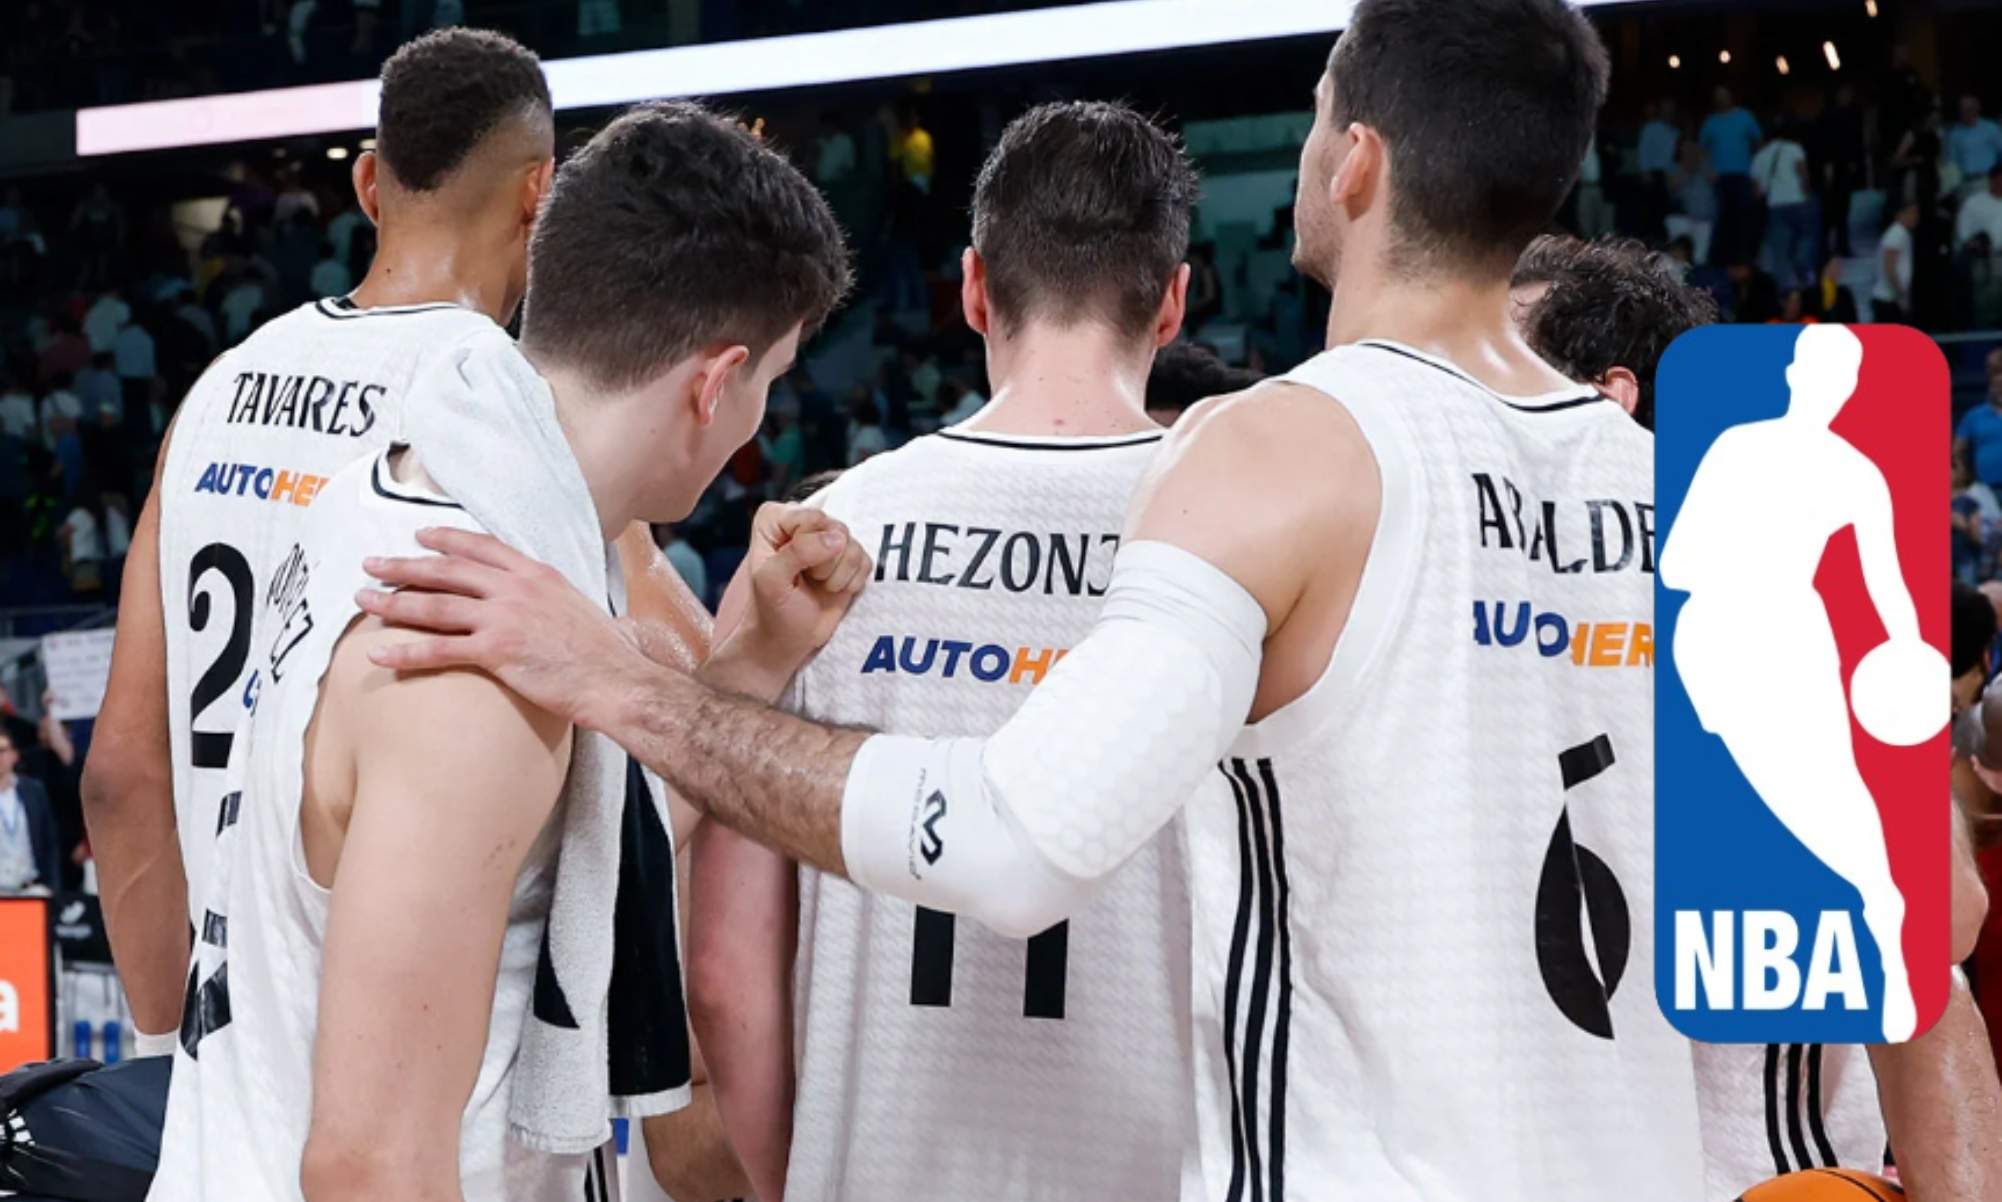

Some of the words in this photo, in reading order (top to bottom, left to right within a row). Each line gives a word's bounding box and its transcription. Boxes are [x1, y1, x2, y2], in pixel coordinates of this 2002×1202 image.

[228, 372, 387, 437] TAVARES
[860, 635, 1070, 686] AUTOH
[1536, 733, 1631, 1039] 6
